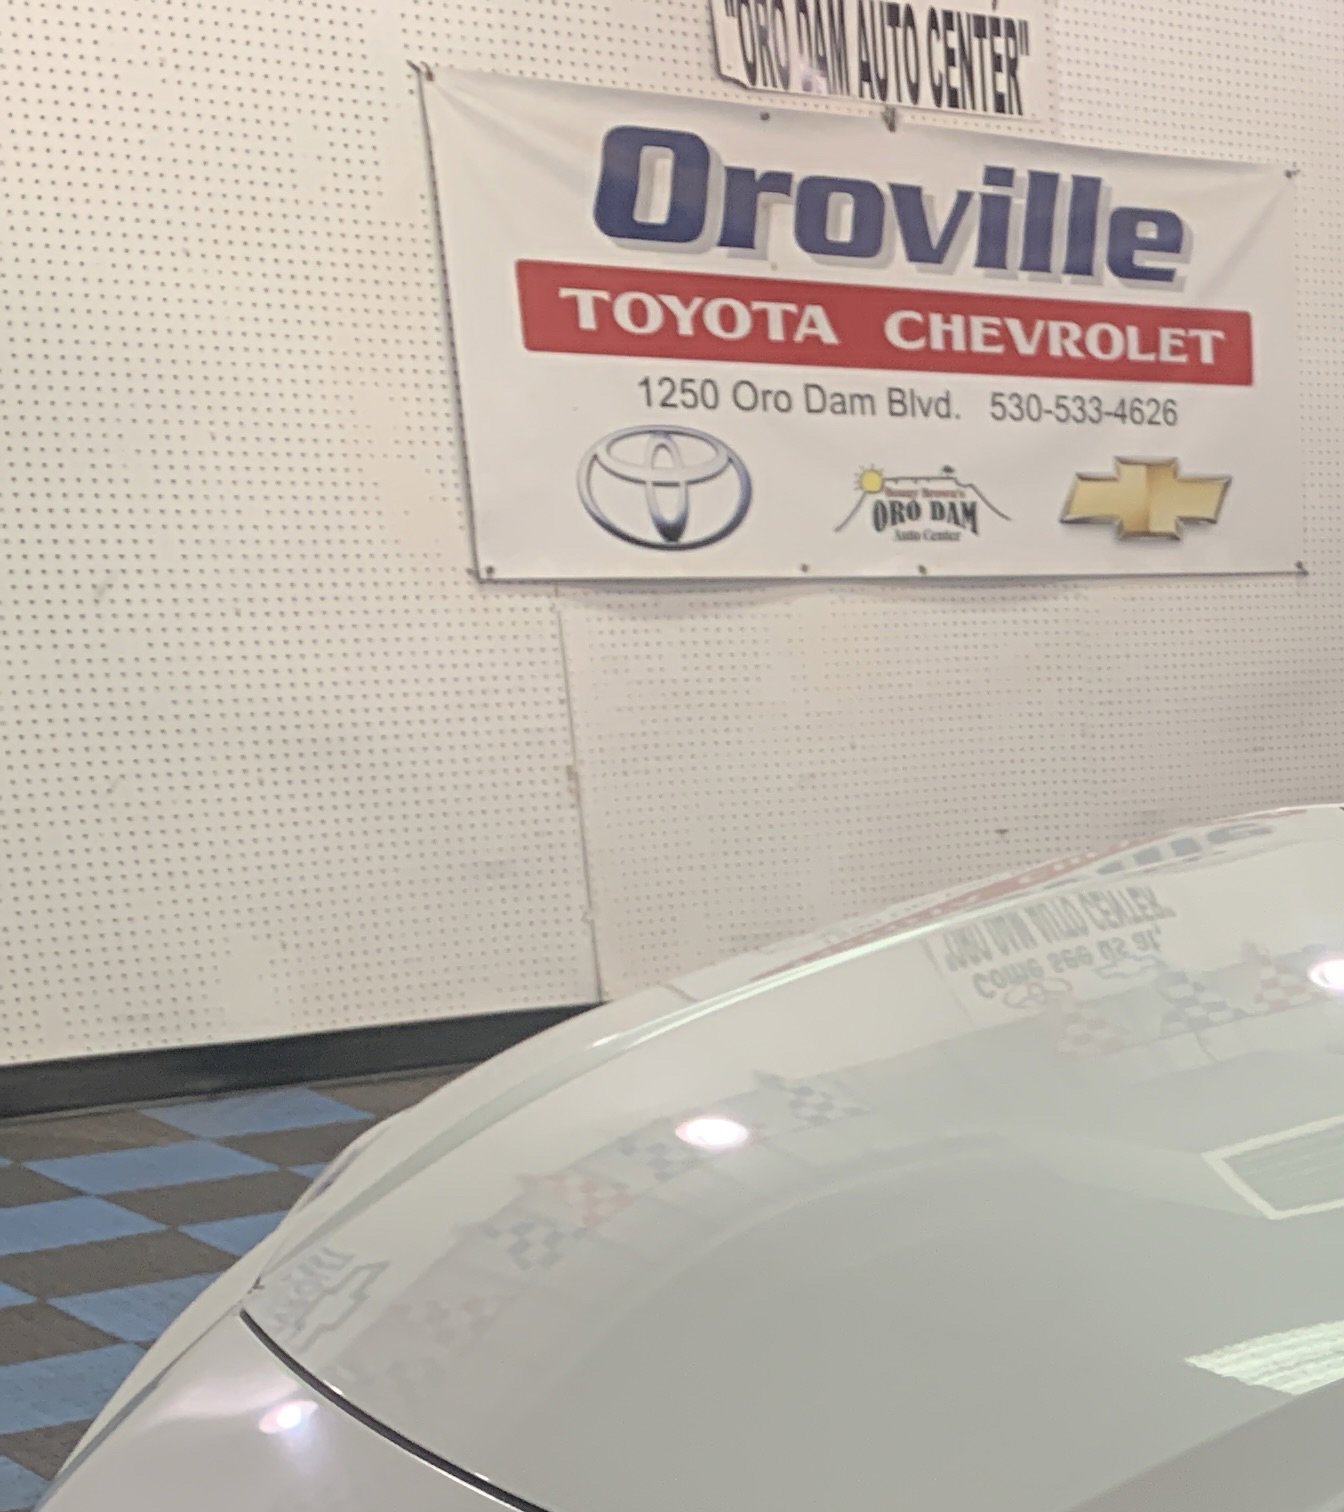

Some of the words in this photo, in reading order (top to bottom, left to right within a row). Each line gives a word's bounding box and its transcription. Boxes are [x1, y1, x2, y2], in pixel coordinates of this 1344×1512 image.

[797, 0, 851, 96] DAM
[859, 0, 921, 106] AUTO
[928, 6, 1030, 116] CENTER"
[594, 124, 1188, 286] Oroville
[559, 287, 839, 345] TOYOTA
[883, 310, 1224, 365] CHEVROLET
[637, 377, 719, 411] 1250
[732, 380, 792, 413] Oro
[804, 383, 875, 417] Dam
[888, 387, 961, 420] Blvd.
[990, 392, 1178, 427] 530-533-4626
[872, 499, 922, 533] ORO
[930, 500, 979, 535] DAM
